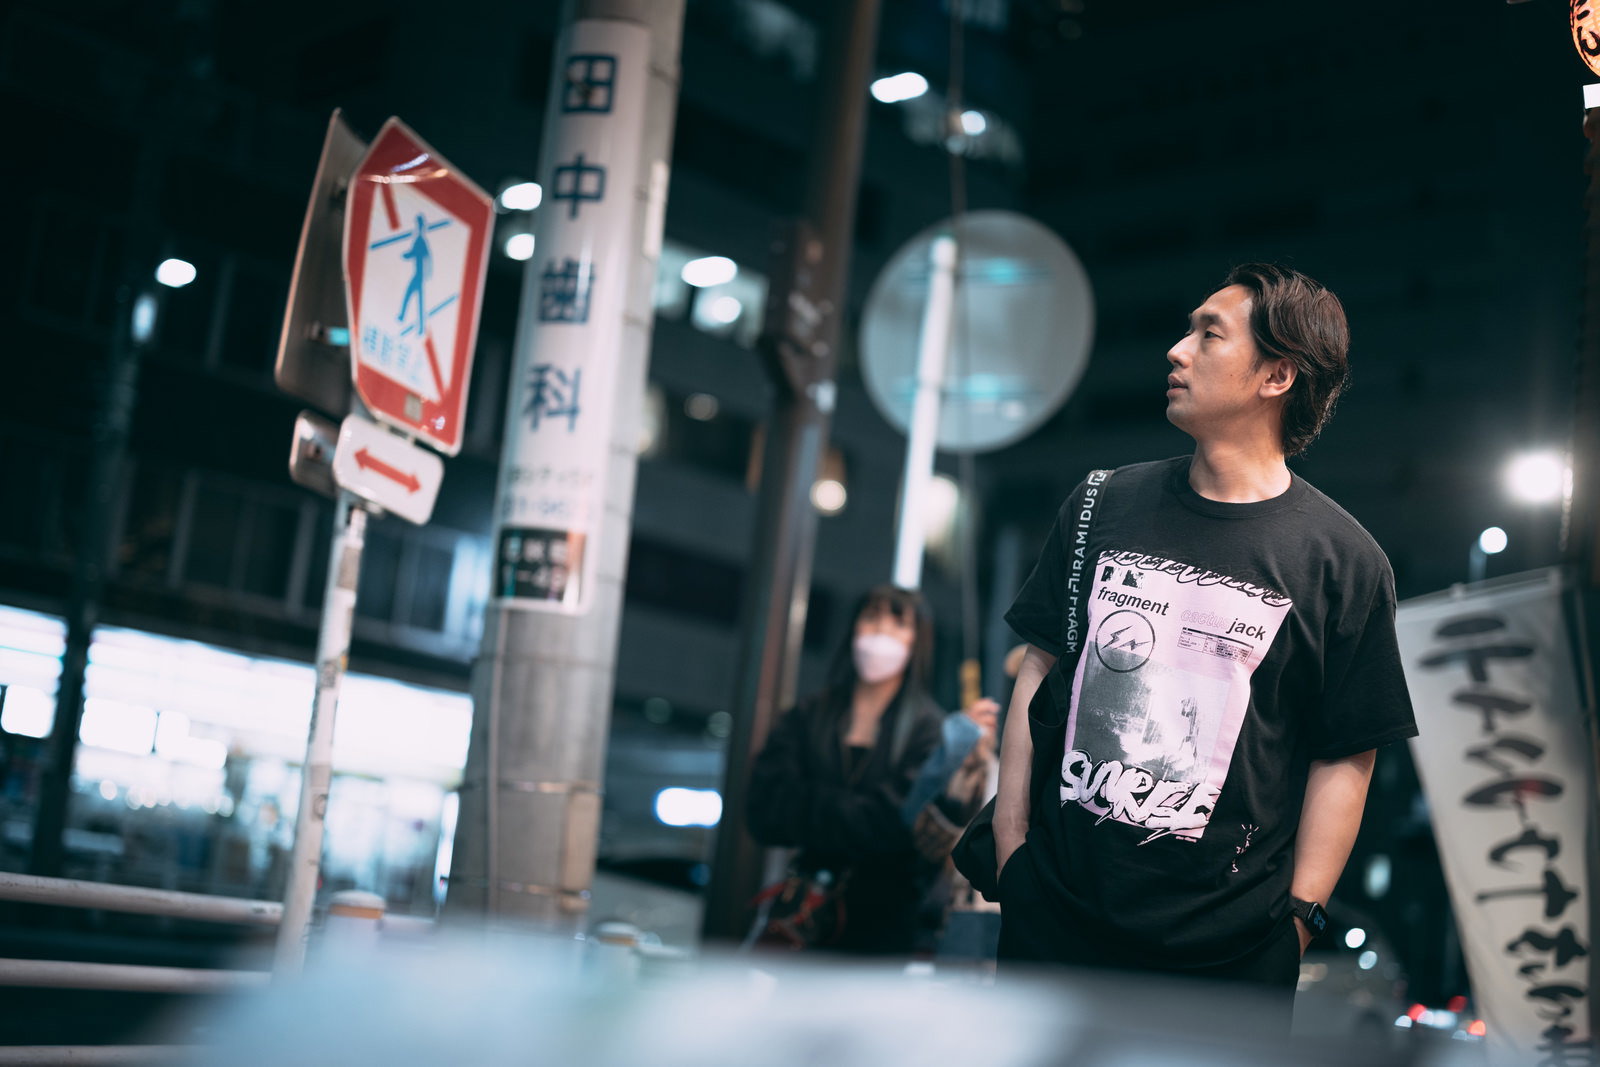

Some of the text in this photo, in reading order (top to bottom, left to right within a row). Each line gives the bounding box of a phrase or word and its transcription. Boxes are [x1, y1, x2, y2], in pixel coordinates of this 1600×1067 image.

[523, 53, 619, 432] 田中歯科
[1071, 486, 1099, 571] RAMIDUS
[1097, 587, 1170, 616] fragment
[1225, 617, 1267, 641] jack
